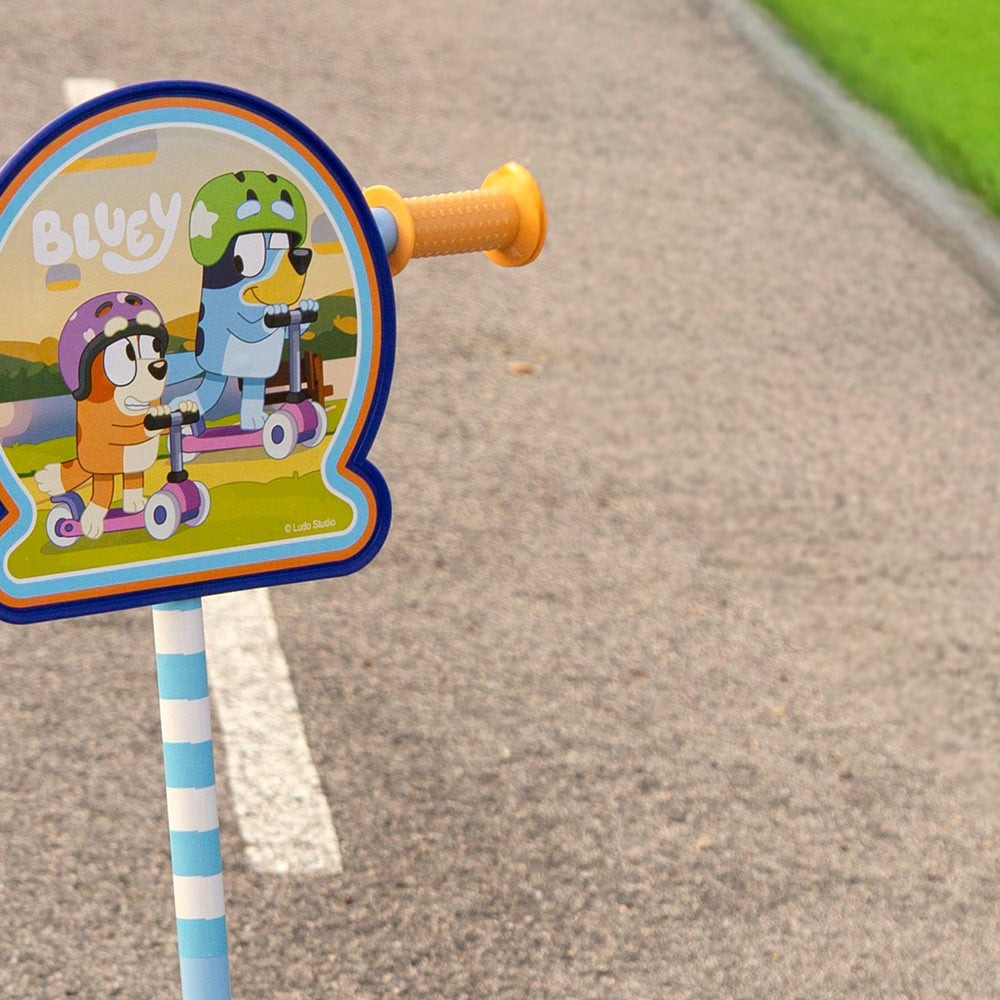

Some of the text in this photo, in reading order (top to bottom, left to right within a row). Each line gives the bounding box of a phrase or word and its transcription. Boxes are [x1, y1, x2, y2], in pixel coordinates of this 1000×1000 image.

[32, 192, 182, 275] BLUEY
[293, 521, 311, 532] Ludo
[313, 518, 336, 529] Studio
